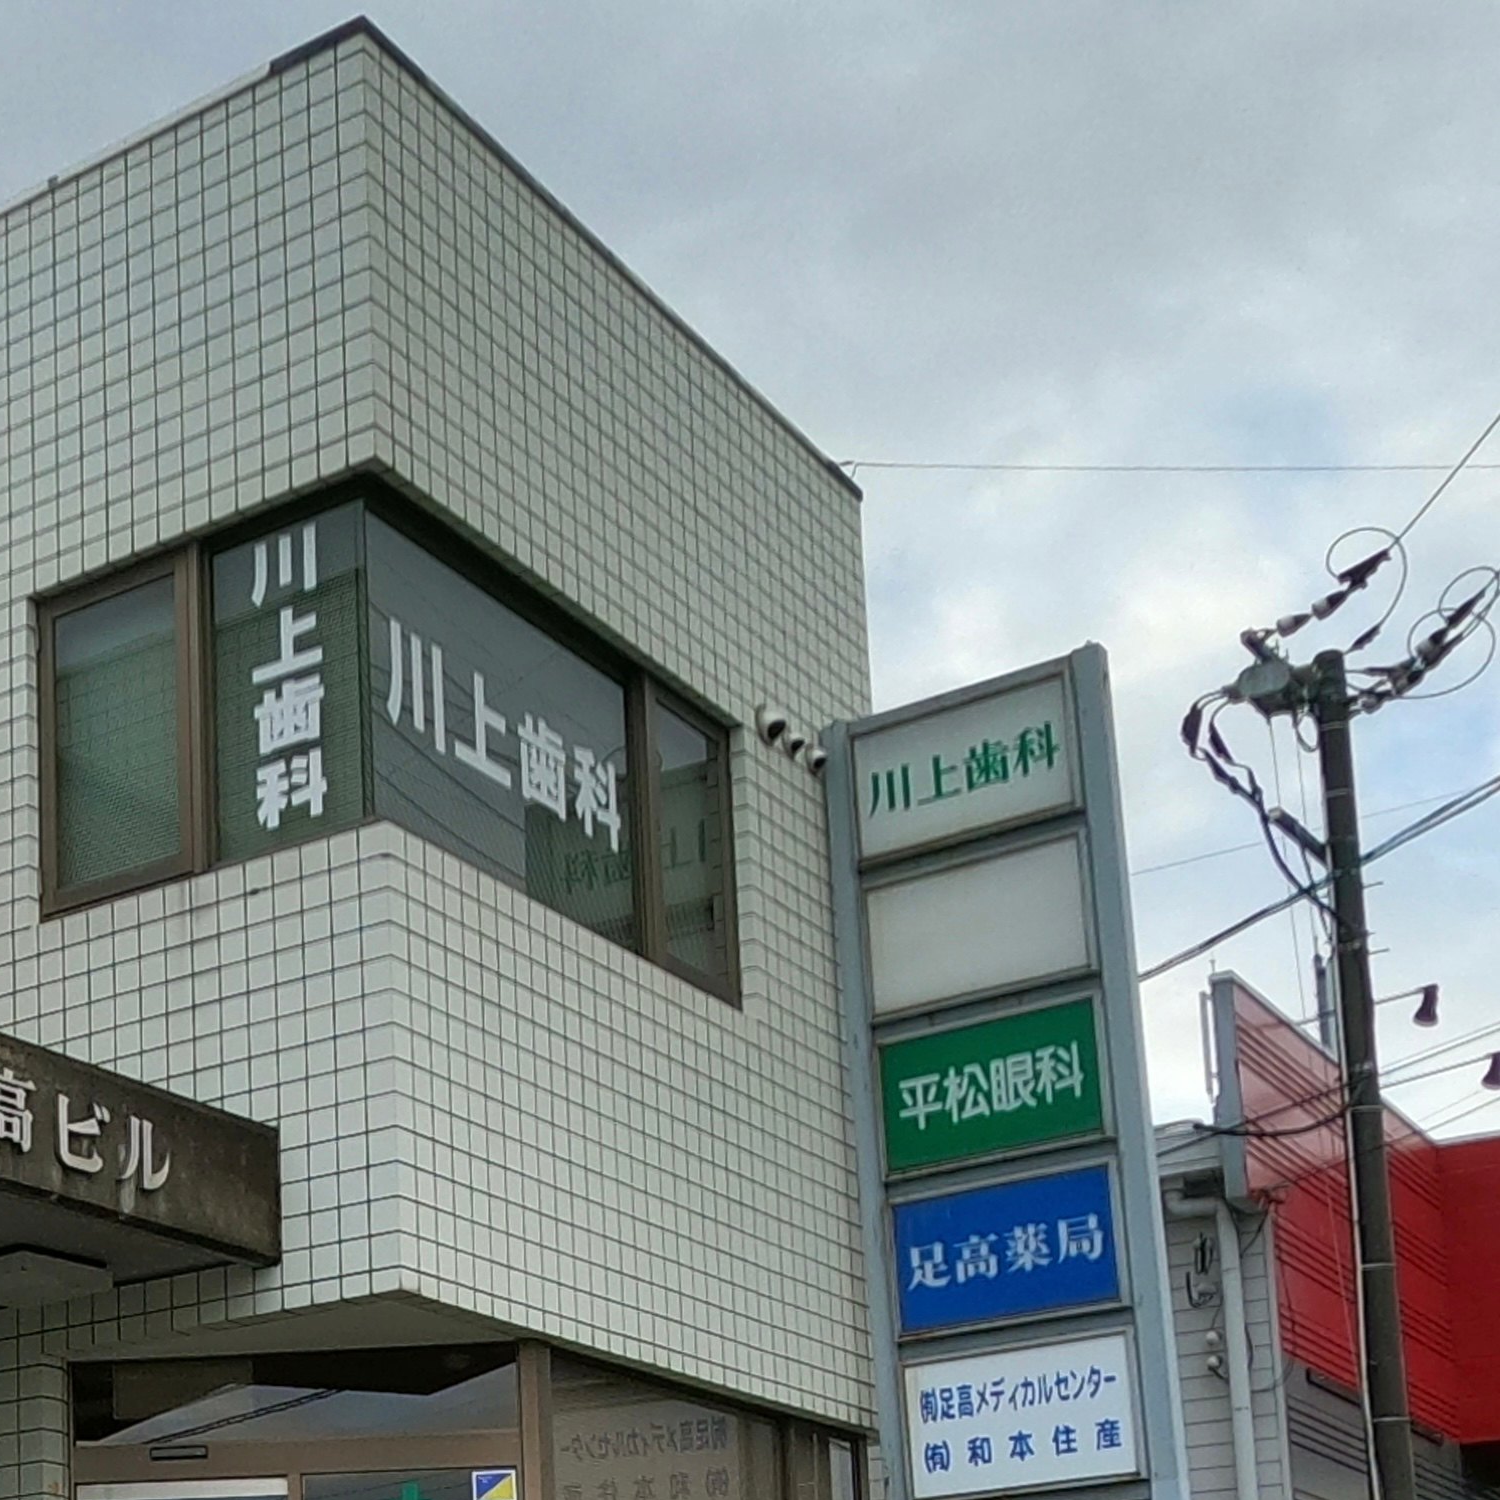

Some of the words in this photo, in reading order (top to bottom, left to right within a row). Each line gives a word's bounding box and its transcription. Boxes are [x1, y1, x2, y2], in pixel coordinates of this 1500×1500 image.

[252, 521, 327, 830] 川上歯科
[386, 616, 621, 852] 川上歯科
[869, 720, 1061, 819] 川上歯科
[899, 1040, 1085, 1130] 平松眼科
[908, 1213, 1105, 1292] 足高薬局
